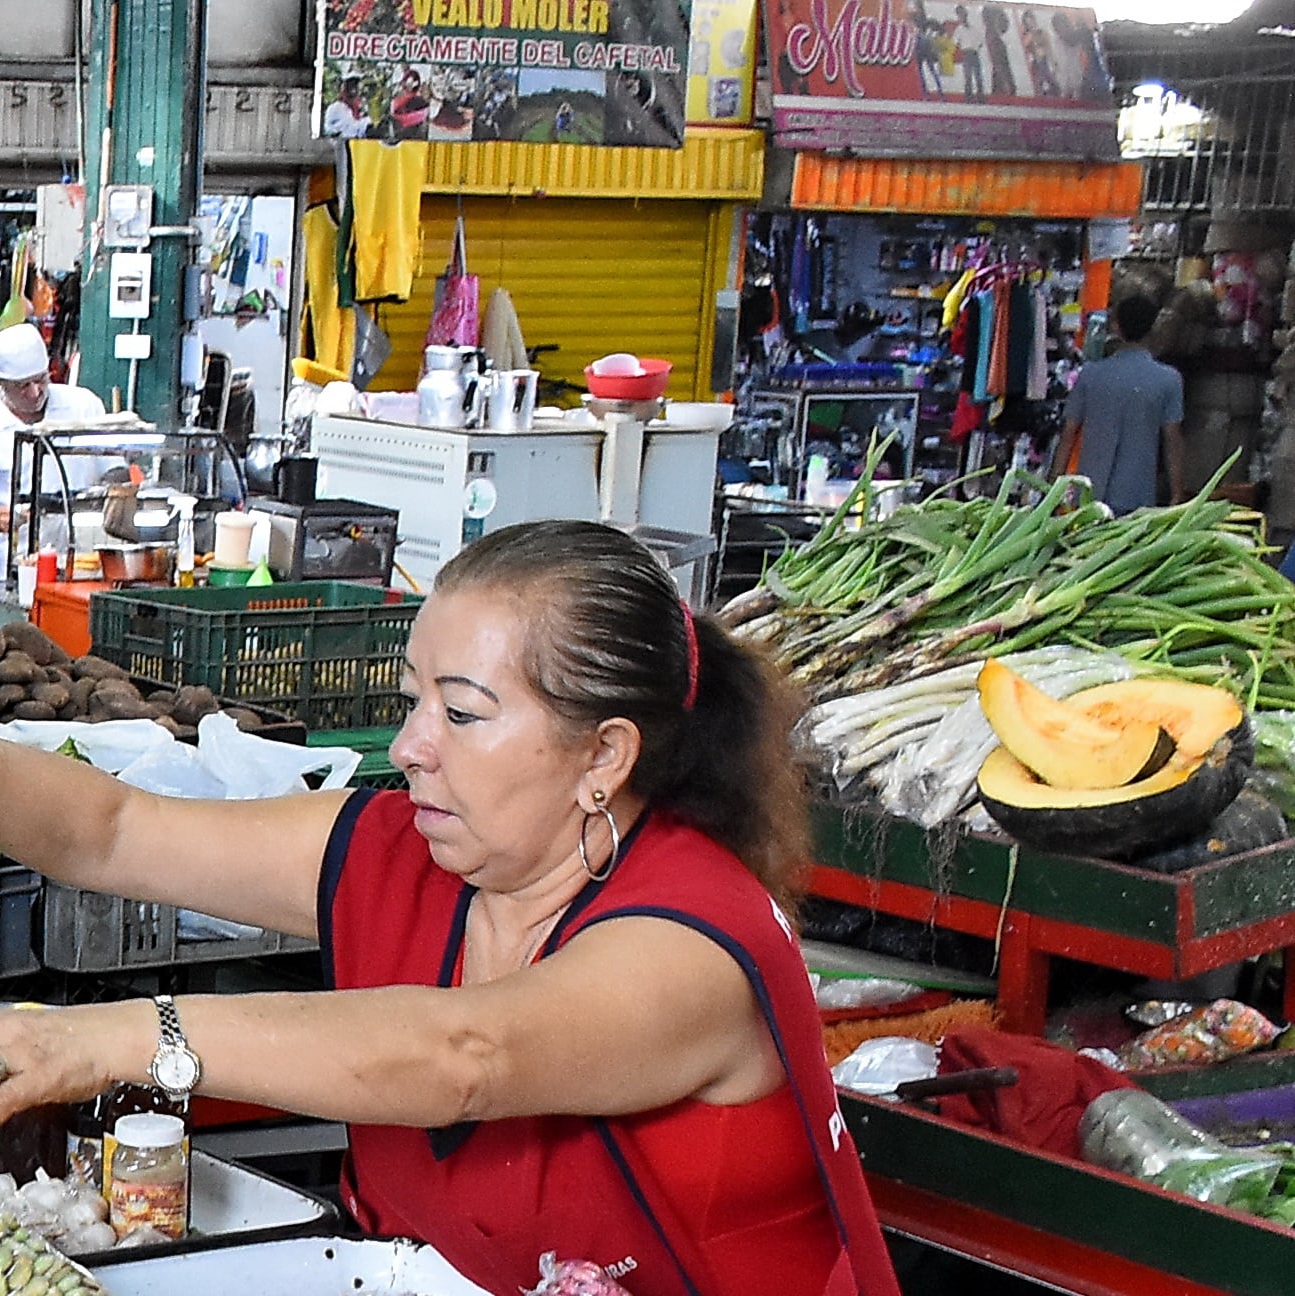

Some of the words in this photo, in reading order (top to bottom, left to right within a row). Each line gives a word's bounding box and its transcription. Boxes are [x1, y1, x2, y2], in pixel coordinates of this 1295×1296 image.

[327, 31, 519, 66] DIRECTAMENTE
[522, 39, 571, 68] DEL
[574, 41, 682, 73] CAFETAL
